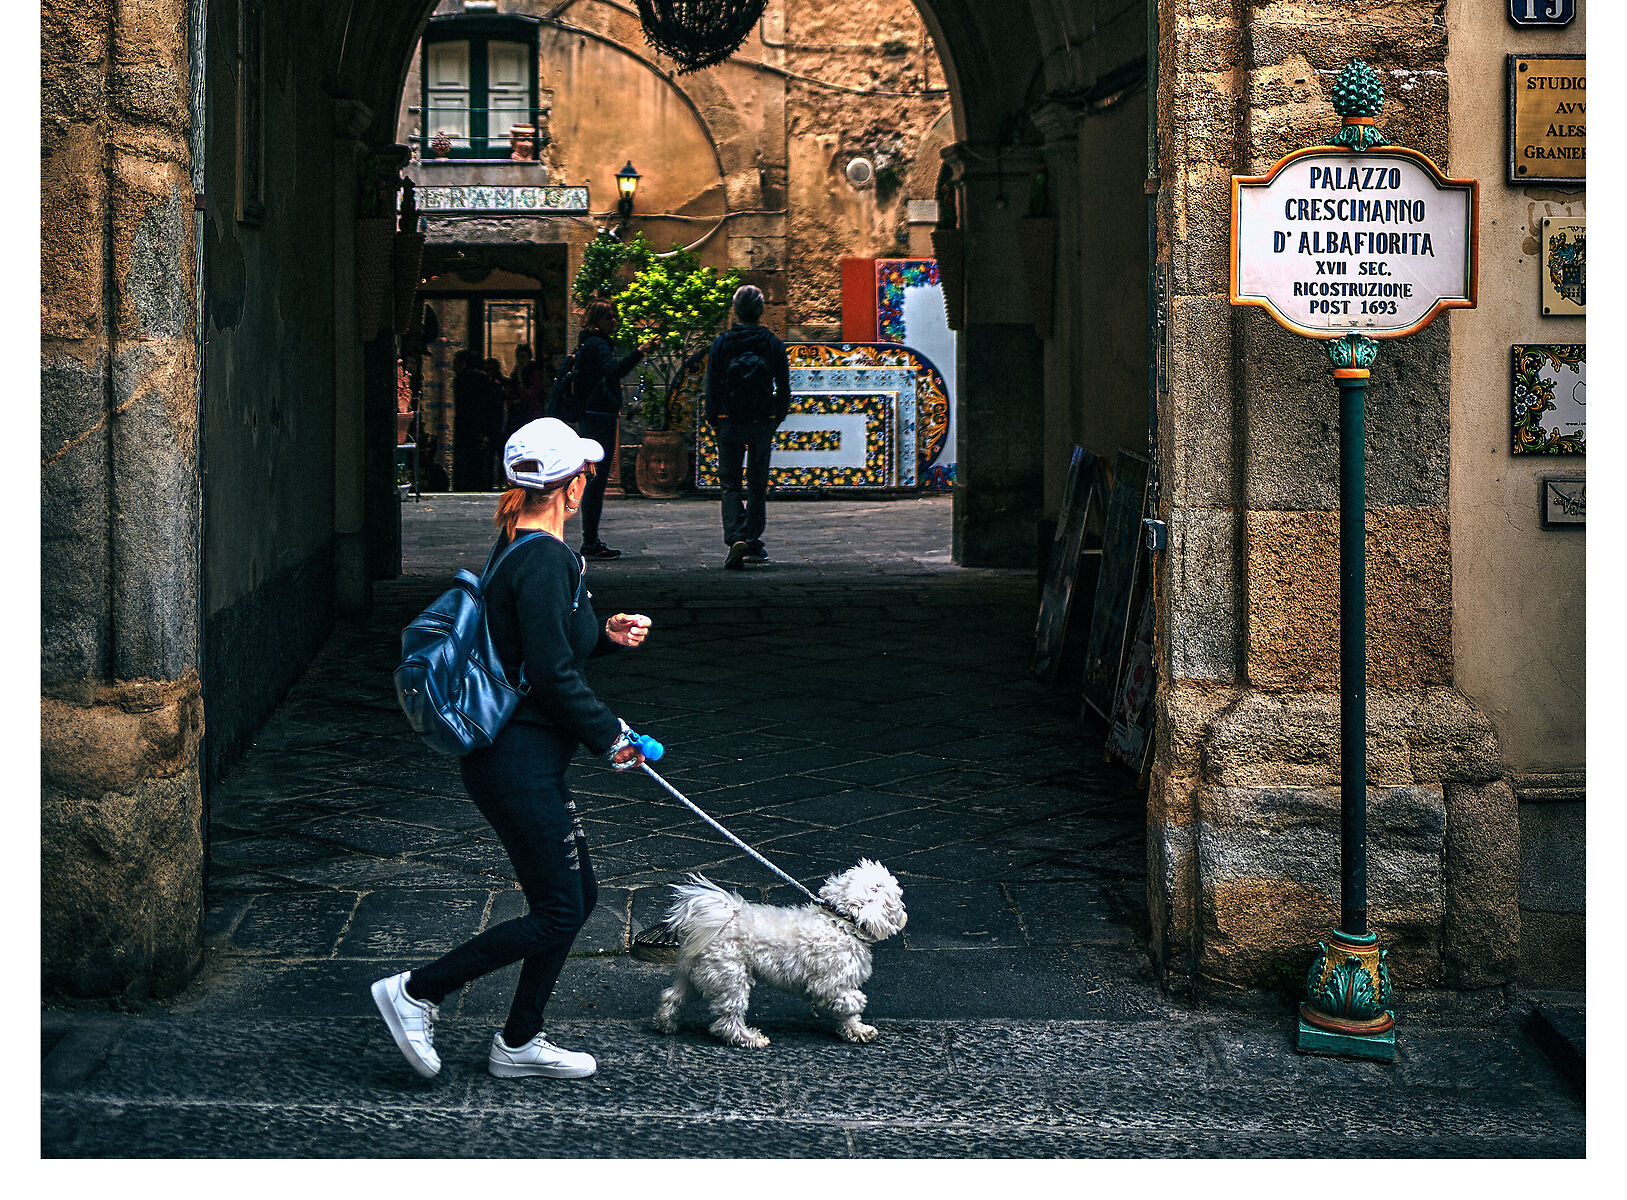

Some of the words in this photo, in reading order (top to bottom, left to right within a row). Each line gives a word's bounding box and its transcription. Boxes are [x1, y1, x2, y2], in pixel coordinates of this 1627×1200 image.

[1545, 123, 1586, 137] ALES
[1310, 166, 1401, 192] PALAZZO
[422, 186, 588, 209] ERAMICA
[1285, 198, 1425, 224] CRESCIMANNO
[1299, 231, 1435, 257] ALBAFIORITA
[1315, 261, 1347, 275] XVII
[1358, 261, 1392, 276] SEC.
[1293, 282, 1413, 298] RICOSTRUZIONE
[1309, 300, 1350, 315] POST
[1361, 300, 1398, 315] 1693
